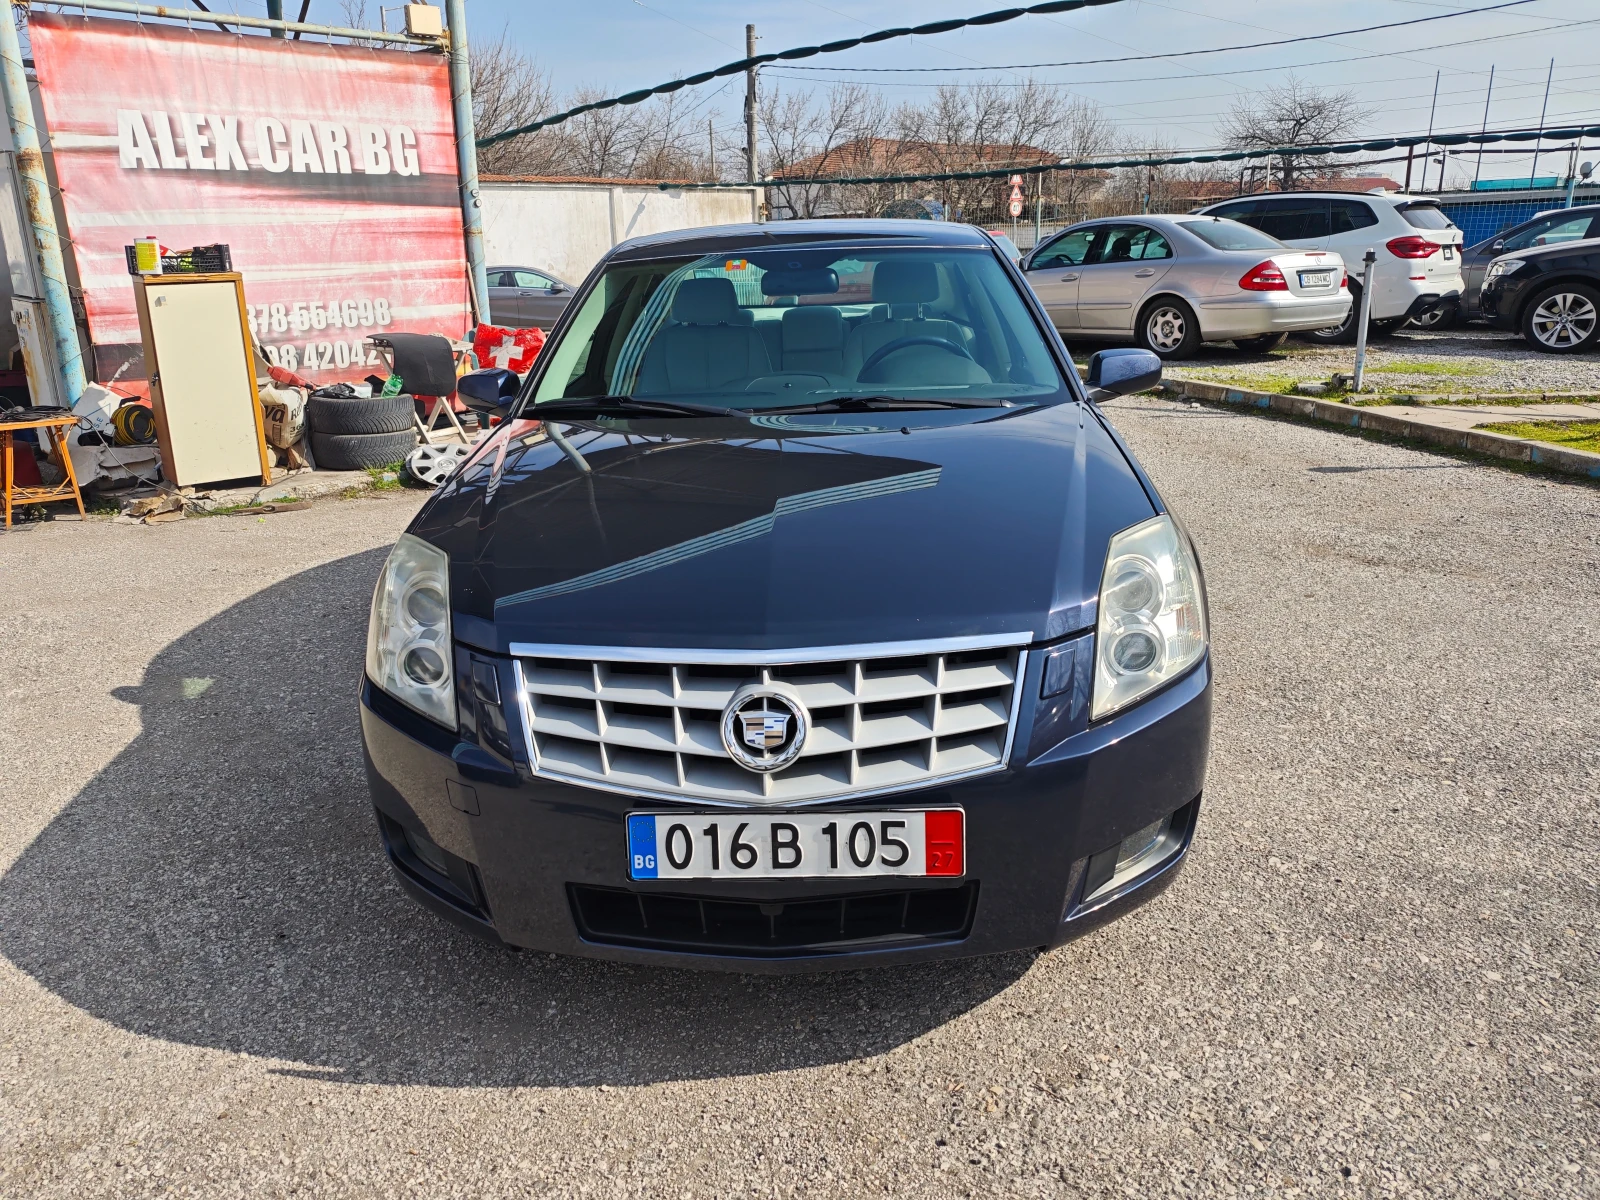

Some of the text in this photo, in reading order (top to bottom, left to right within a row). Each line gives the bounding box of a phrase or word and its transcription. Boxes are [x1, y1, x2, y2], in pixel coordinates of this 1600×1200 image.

[117, 108, 420, 177] ALEX CAR BG
[303, 339, 391, 371] 42042
[665, 820, 909, 870] 016 B 105
[932, 851, 954, 867] 27
[634, 855, 655, 869] BG
